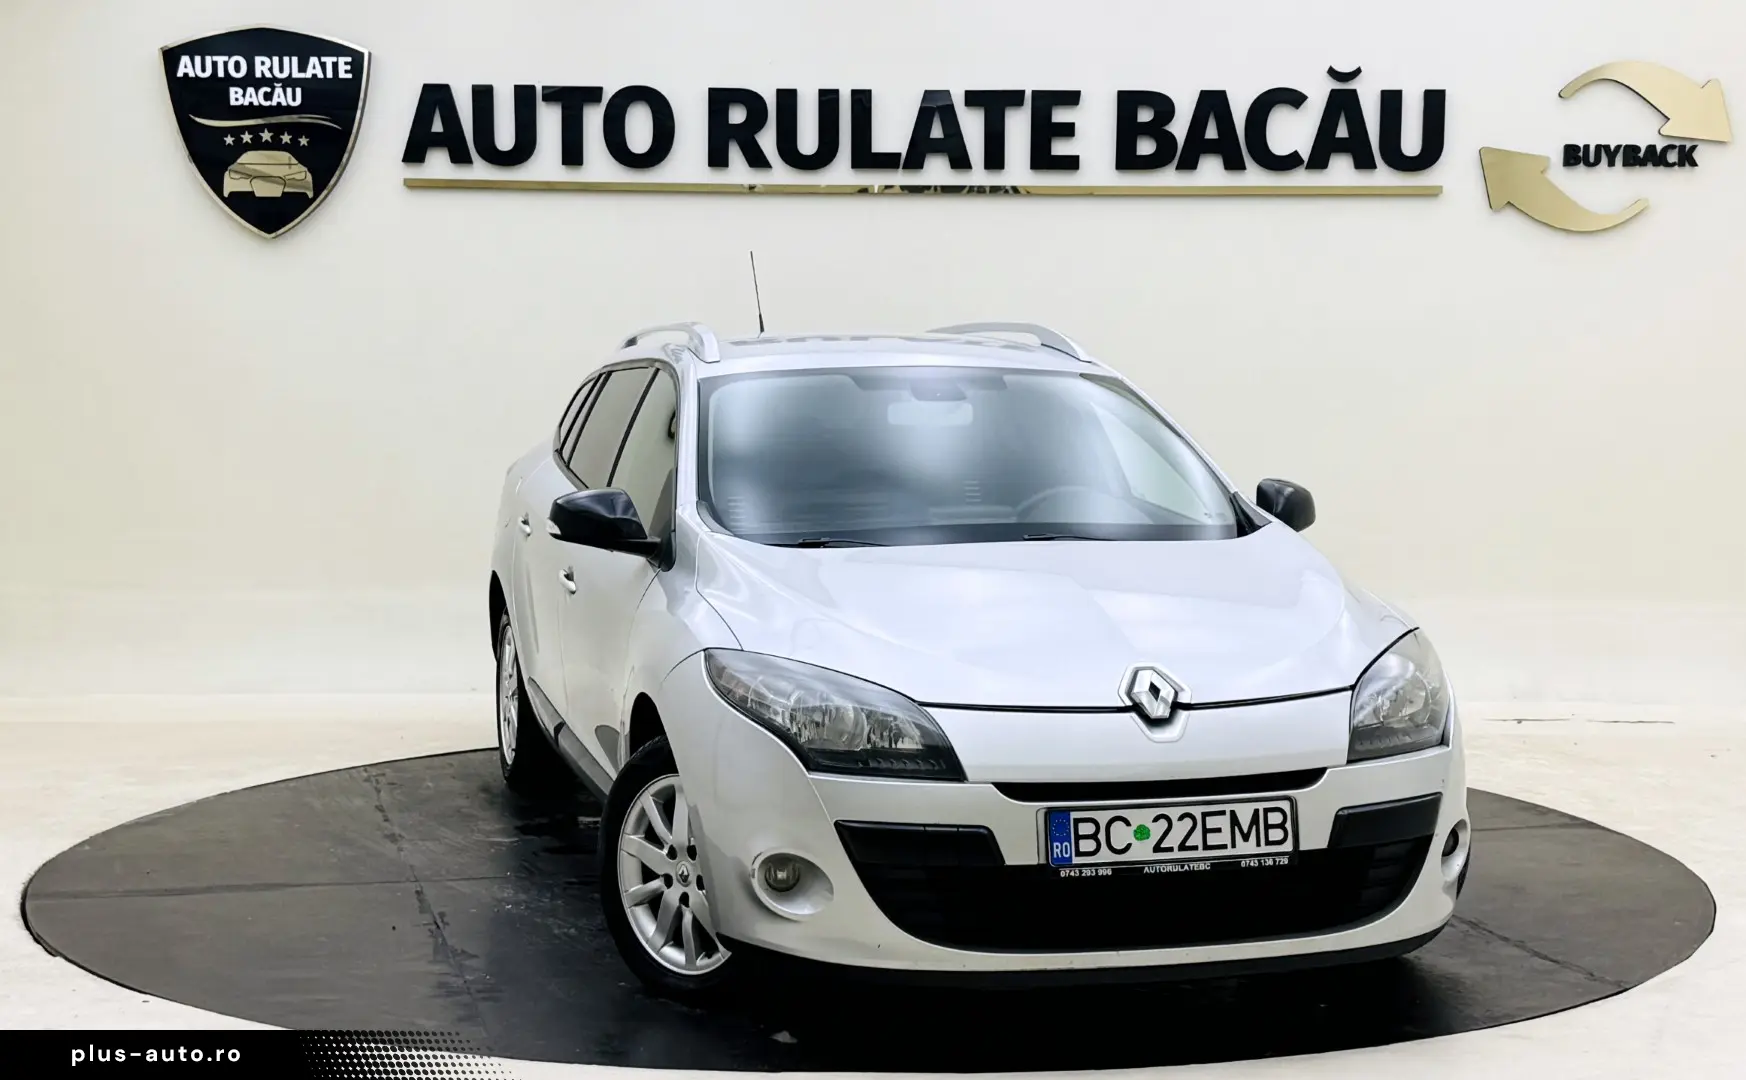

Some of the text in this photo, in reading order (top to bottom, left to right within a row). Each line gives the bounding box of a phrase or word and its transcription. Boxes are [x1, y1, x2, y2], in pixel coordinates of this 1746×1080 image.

[177, 55, 353, 79] AUTO RULATE
[229, 83, 302, 107] BACĂU
[402, 65, 1447, 172] AUTO RULATE BACĂU
[1562, 143, 1699, 168] BUYBACK
[1053, 806, 1290, 858] RO BC 22EMB
[1060, 868, 1080, 877] 0743
[1240, 859, 1259, 868] 0743
